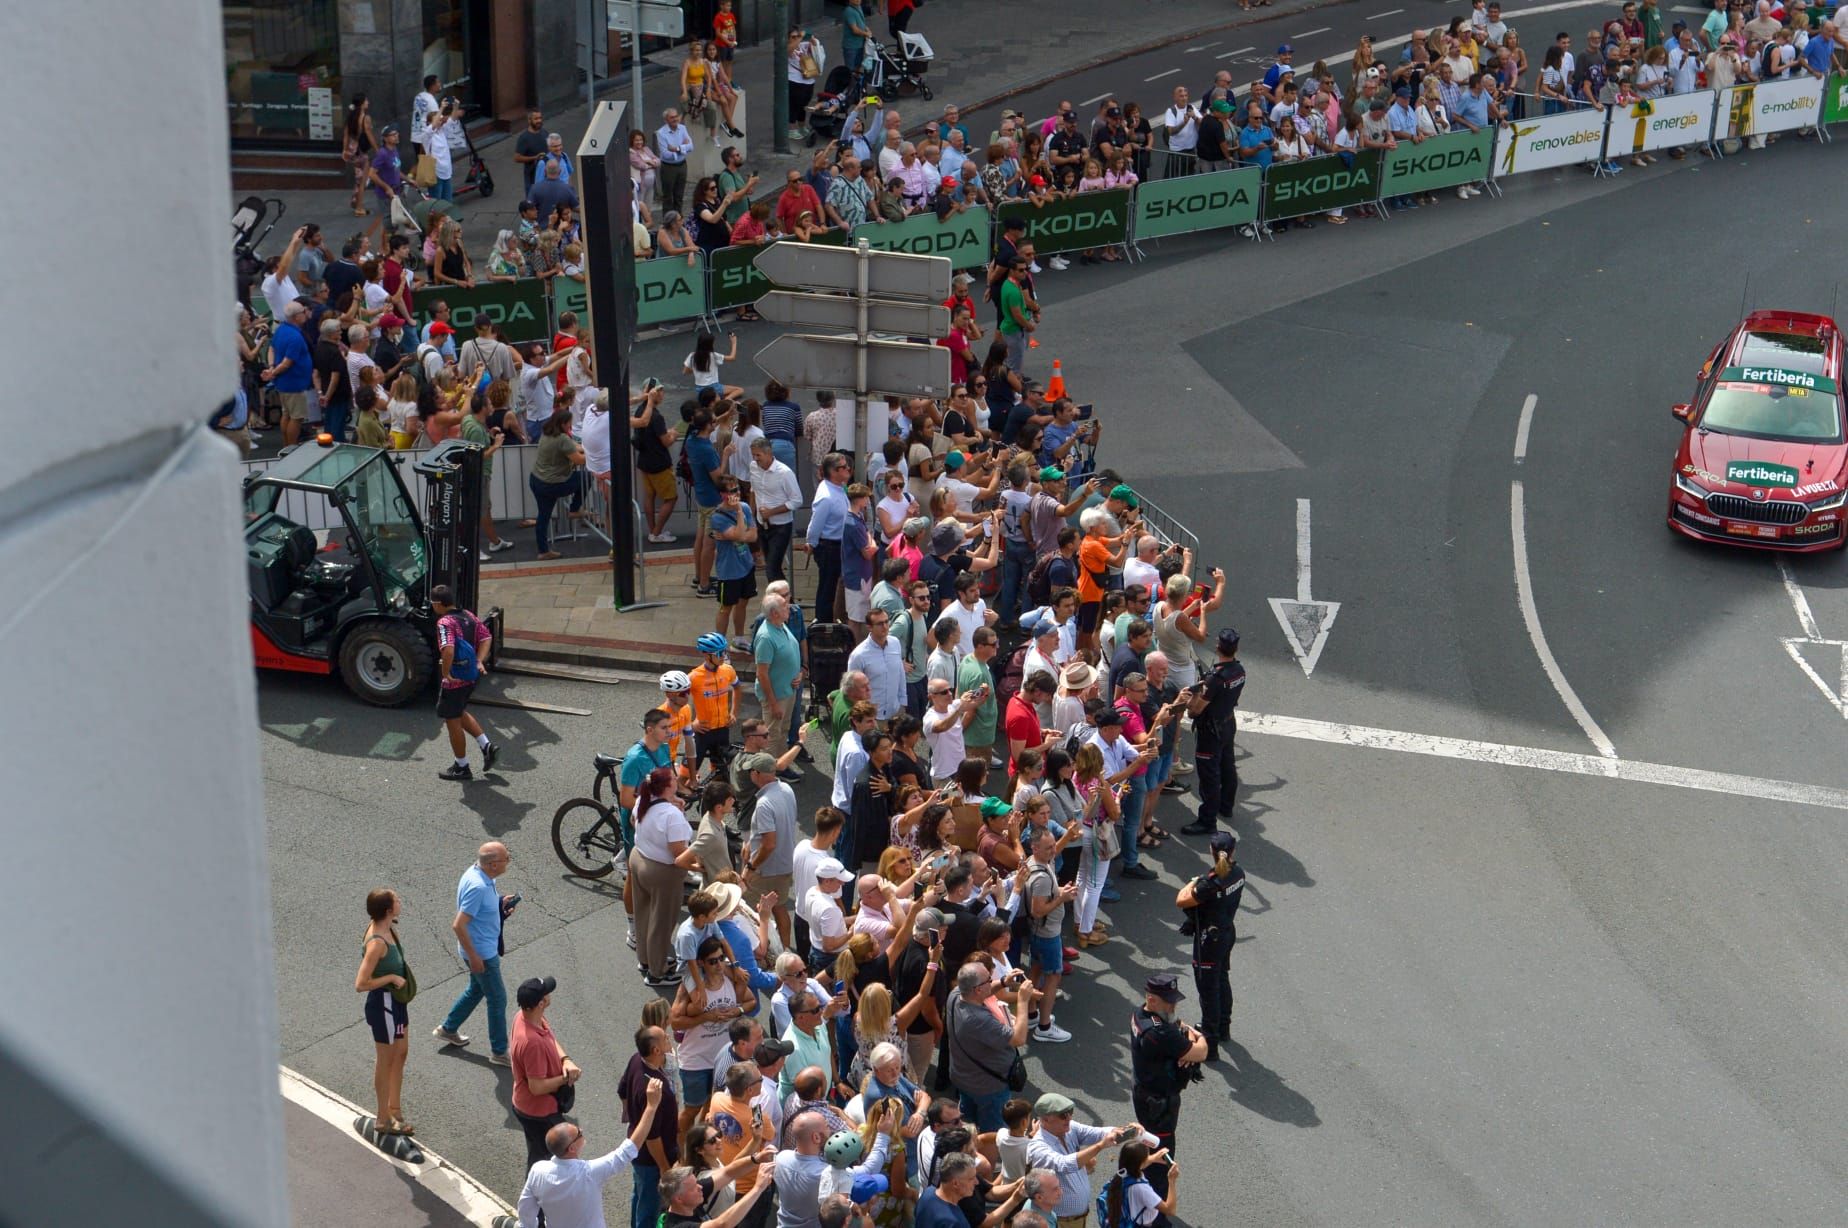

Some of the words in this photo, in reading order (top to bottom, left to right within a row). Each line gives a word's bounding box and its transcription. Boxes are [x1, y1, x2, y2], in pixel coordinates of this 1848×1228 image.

[1761, 96, 1817, 115] e-mobility
[1652, 110, 1699, 132] energía
[1530, 130, 1601, 153] renovables
[1391, 147, 1482, 178] SKODA
[1274, 168, 1370, 201] SKODA
[1146, 188, 1249, 220] SKODA
[1023, 209, 1118, 238] KODA
[1742, 368, 1815, 387] Fertiberia
[1682, 464, 1728, 487] SKODA
[1728, 467, 1794, 484] Fertiberia
[1790, 486, 1806, 498] LA
[1805, 479, 1839, 494] VUELTA
[1794, 523, 1835, 535] SKODA
